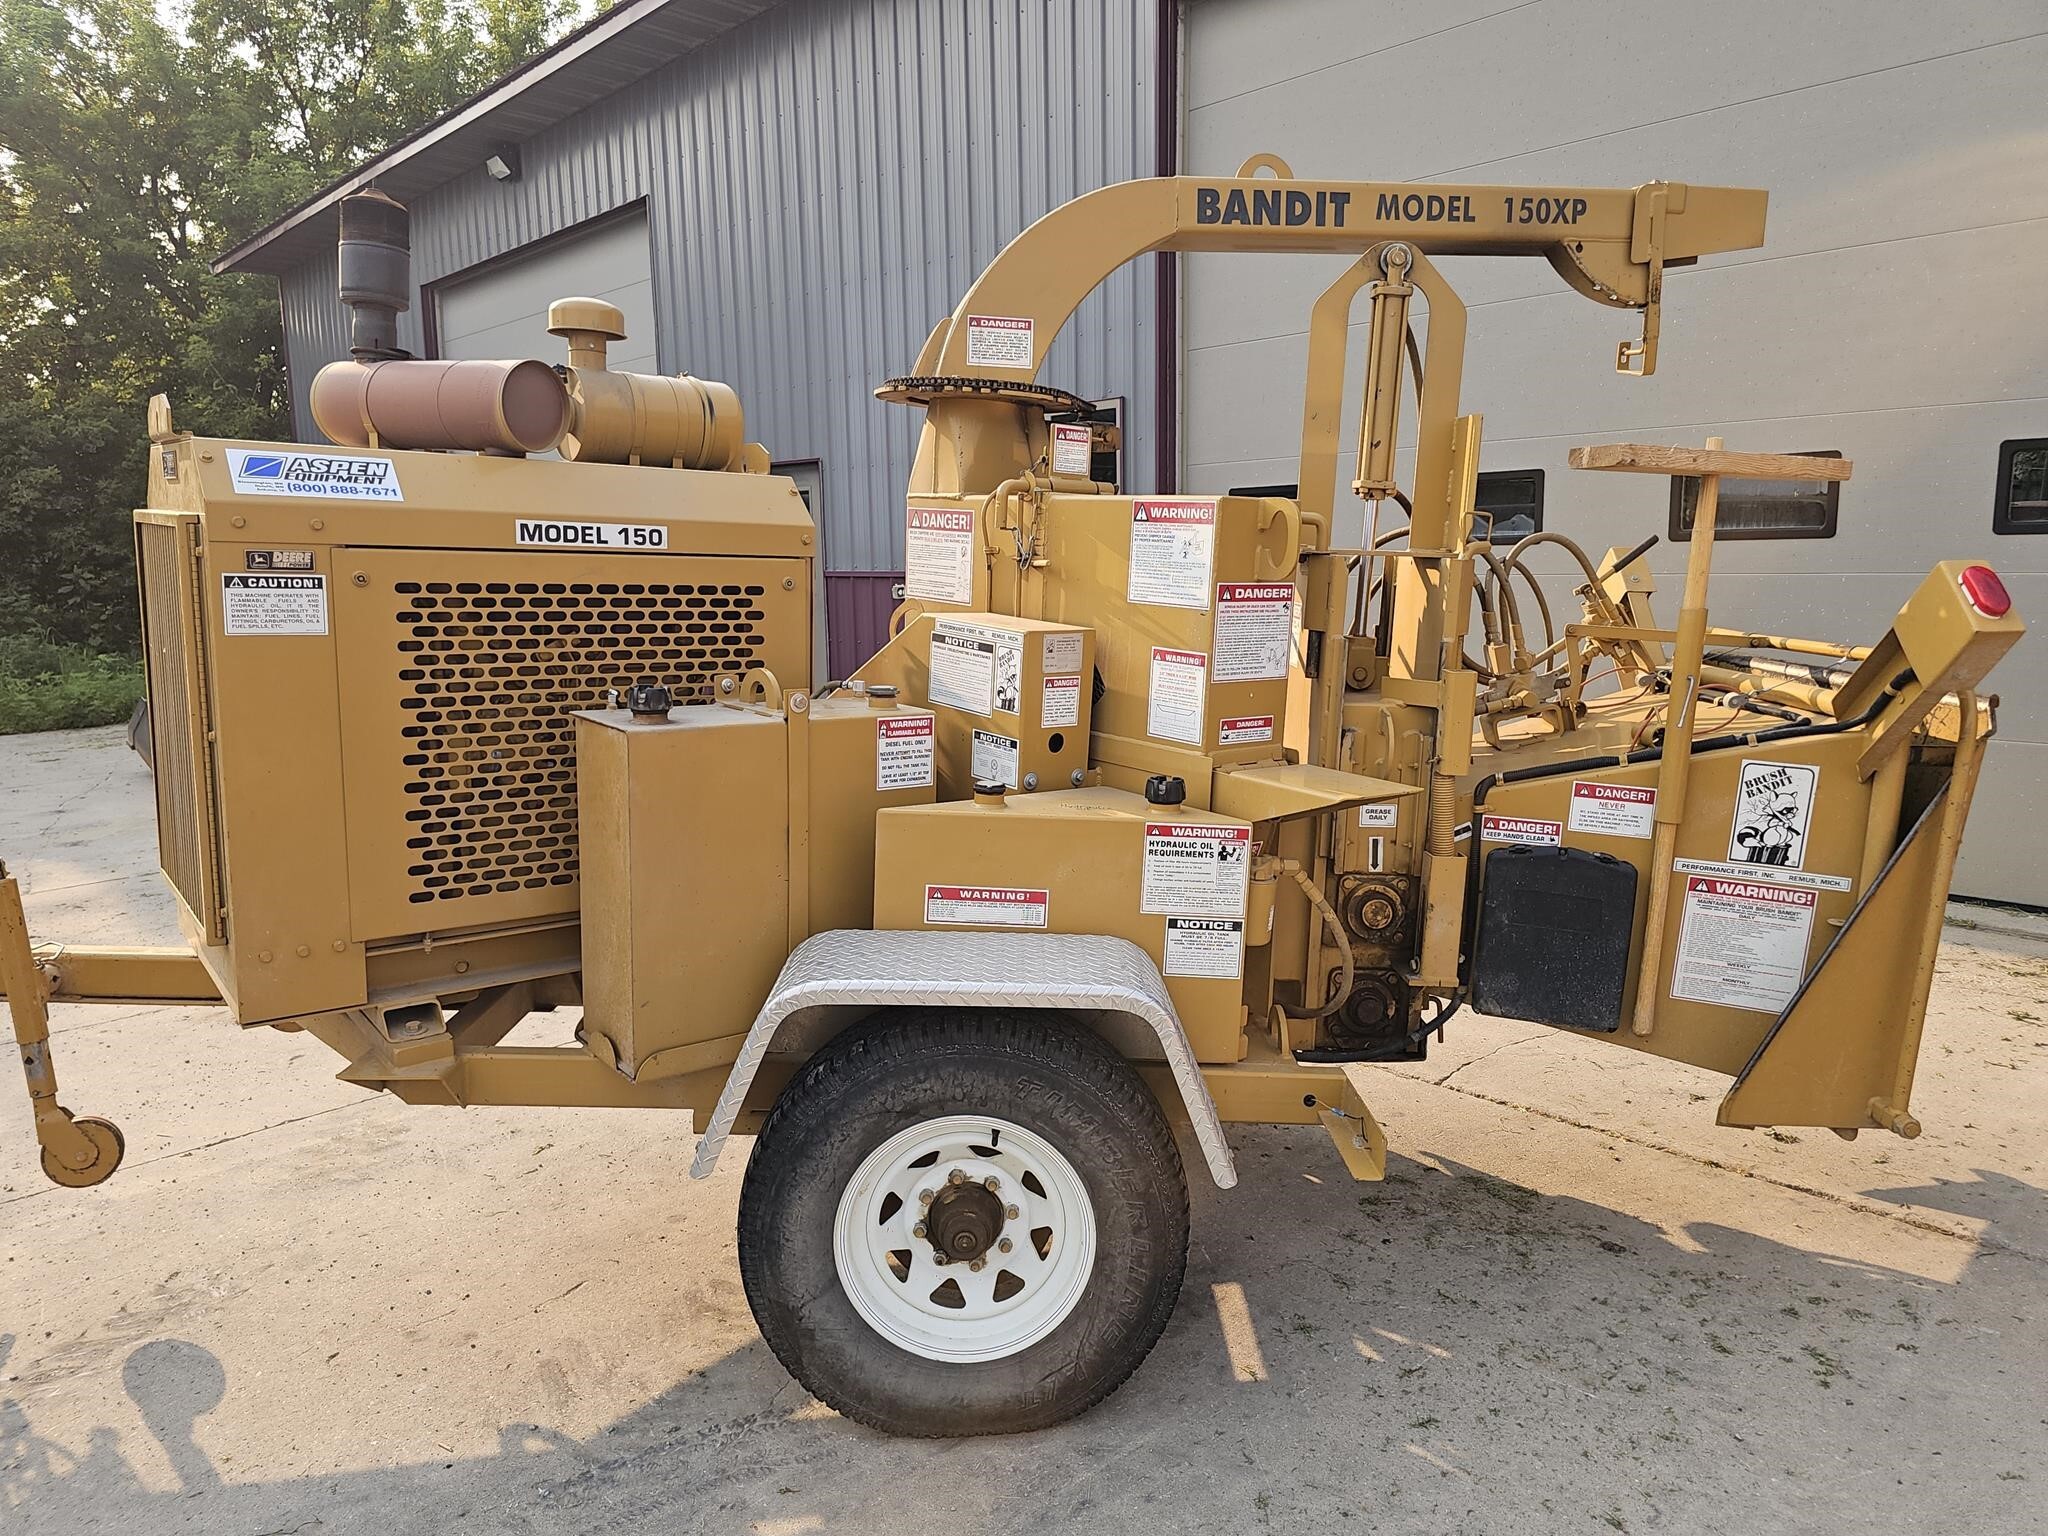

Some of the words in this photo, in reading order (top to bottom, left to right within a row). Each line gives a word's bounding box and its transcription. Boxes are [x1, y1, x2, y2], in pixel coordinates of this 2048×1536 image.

[1196, 188, 1350, 228] BANDIT
[1375, 194, 1476, 222] MODEL
[1503, 197, 1588, 224] 150XP
[980, 320, 1029, 329] DANGER!
[286, 458, 388, 477] ASPEN
[284, 472, 386, 485] EQUIPMENT
[287, 482, 327, 494] (800)
[330, 486, 398, 497] 888-7671
[1150, 506, 1212, 520] WARNING!
[922, 512, 970, 530] DANGER!
[520, 523, 609, 545] MODEL
[618, 528, 663, 546] 150
[272, 552, 312, 563] DEERE
[248, 578, 319, 587] CAUTION!
[1235, 589, 1291, 598] DANGER!
[944, 636, 980, 650] NOTICE
[1166, 654, 1202, 665] WARNING!
[889, 719, 930, 728] WARNING!
[1236, 720, 1264, 728] DANGER!
[980, 733, 1011, 747] NOTICE
[1744, 767, 1788, 790] BRUSH
[1745, 775, 1793, 799] BANDIT
[1596, 788, 1650, 802] DANGER!
[1172, 827, 1237, 838] WARNING!
[1499, 820, 1556, 835] DANGER!
[1503, 832, 1524, 840] HANDS
[1149, 841, 1197, 849] HYDRAULIC
[1148, 849, 1214, 858] REQUIREMENTS
[1681, 863, 1735, 874] PERFORMANCE
[1737, 870, 1759, 878] FIRST,
[1788, 875, 1818, 885] REMUS,
[1820, 879, 1842, 887] MICH.
[960, 890, 1030, 900] WARNING!
[1715, 882, 1812, 904] WARNING!
[1697, 899, 1736, 908] MAINTAINING
[1755, 906, 1775, 914] BRUSH
[1177, 920, 1234, 930] NOTICE
